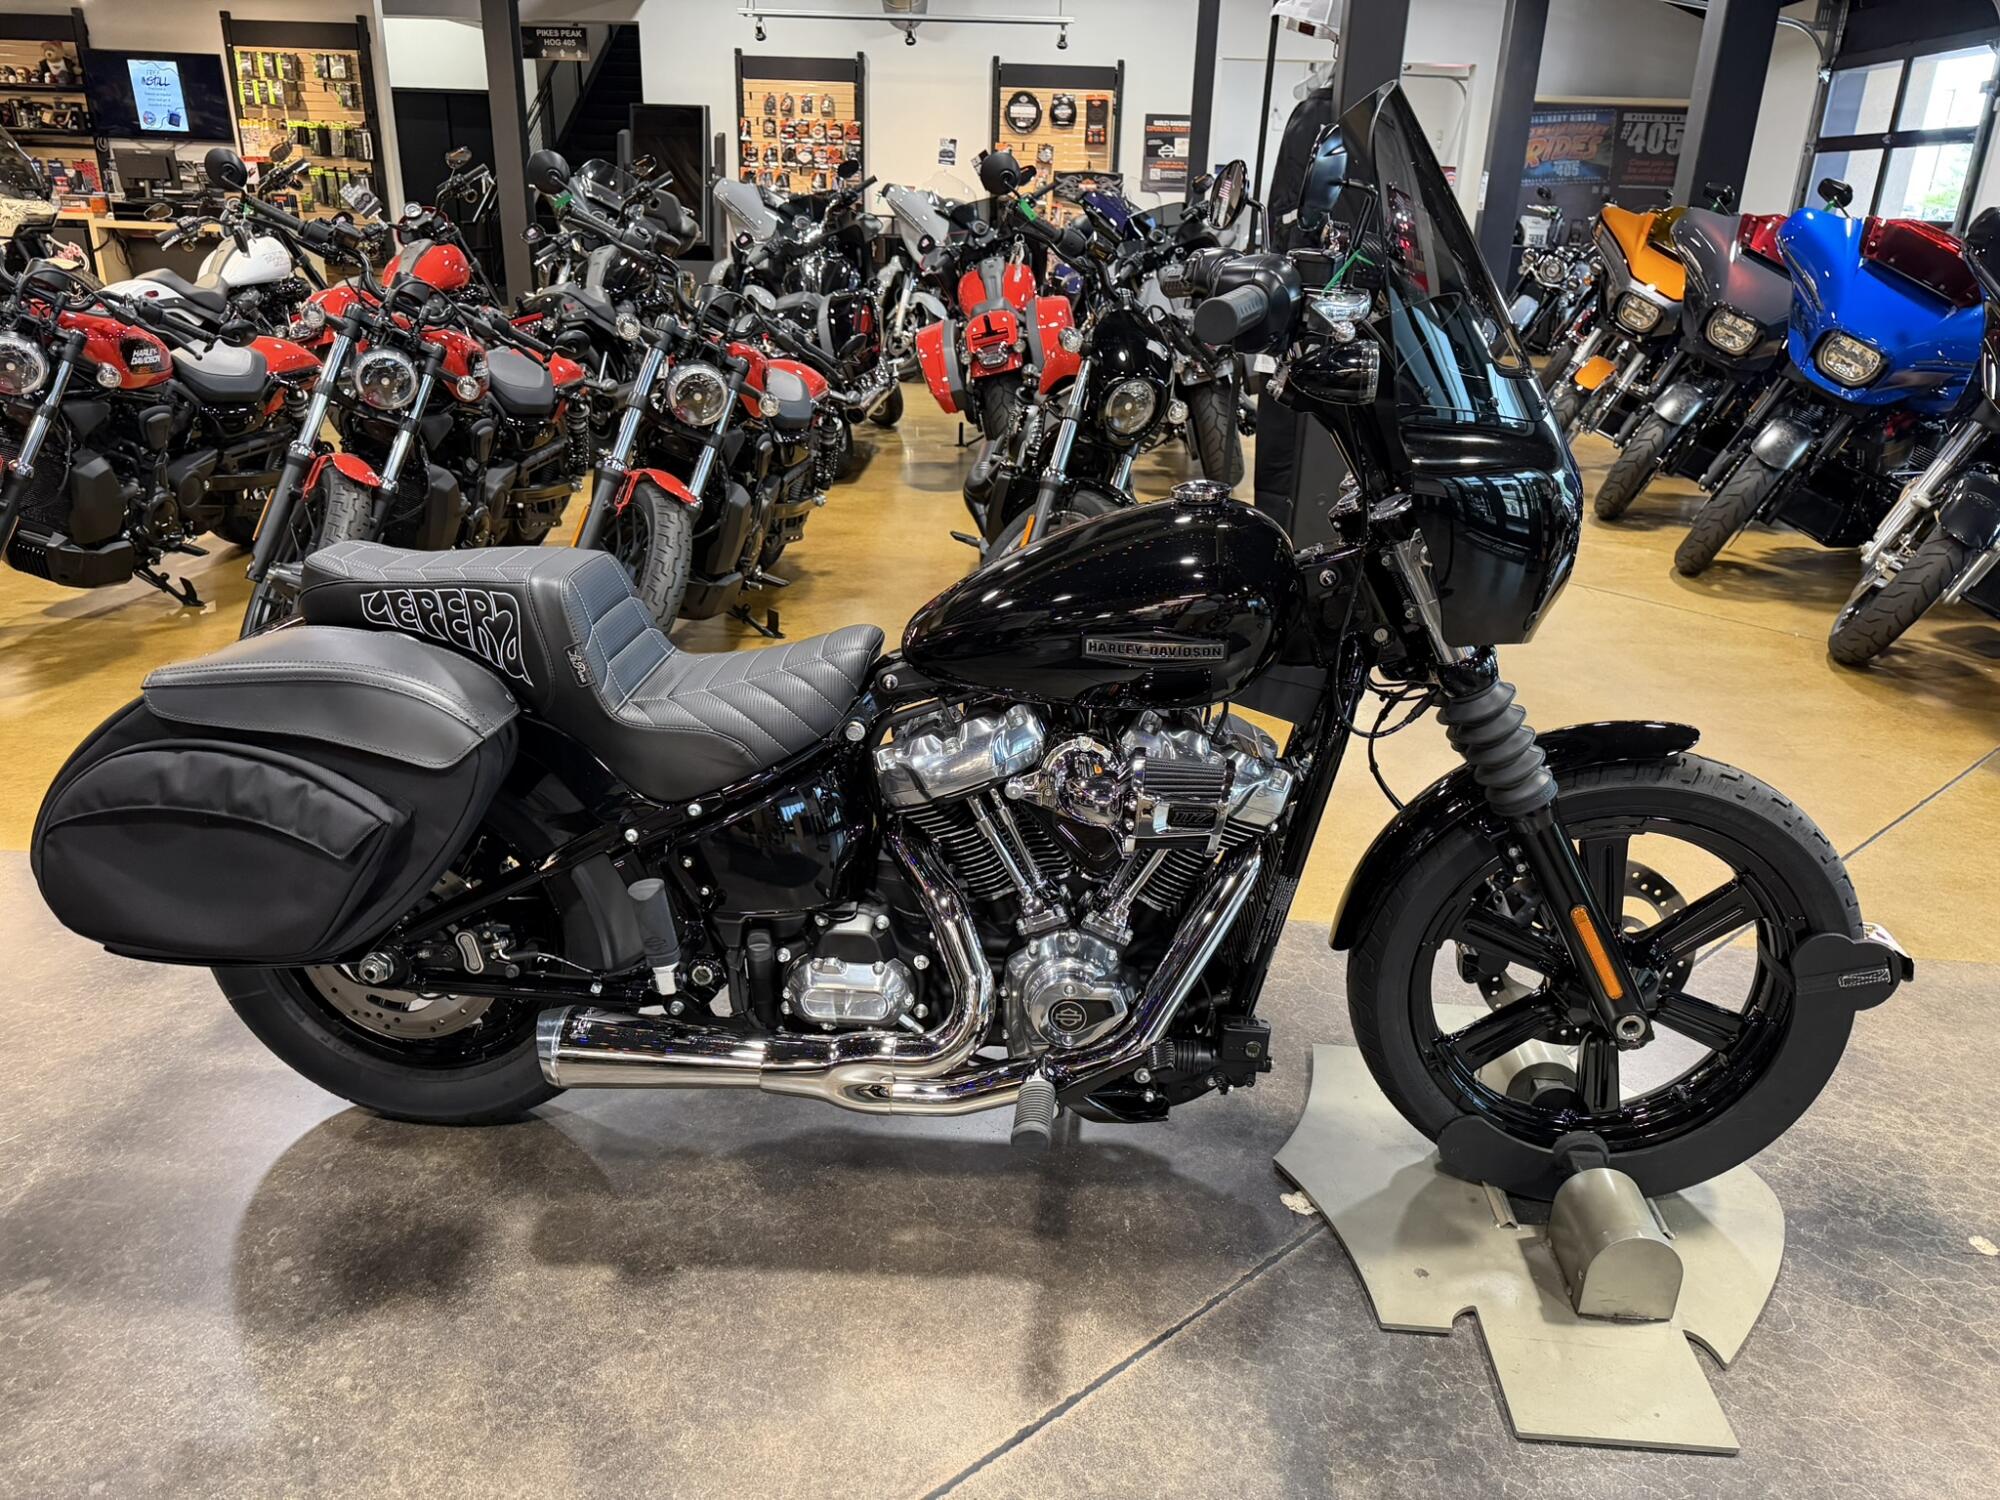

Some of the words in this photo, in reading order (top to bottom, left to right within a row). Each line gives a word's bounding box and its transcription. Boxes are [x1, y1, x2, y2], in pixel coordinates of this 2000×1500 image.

[535, 29, 559, 37] PIKES
[560, 29, 582, 37] PEAK
[543, 38, 561, 46] HOG
[1620, 122, 1685, 156] #405
[1525, 135, 1603, 168] RIDES
[1088, 641, 1222, 657] HARLEY-DAVIDSON
